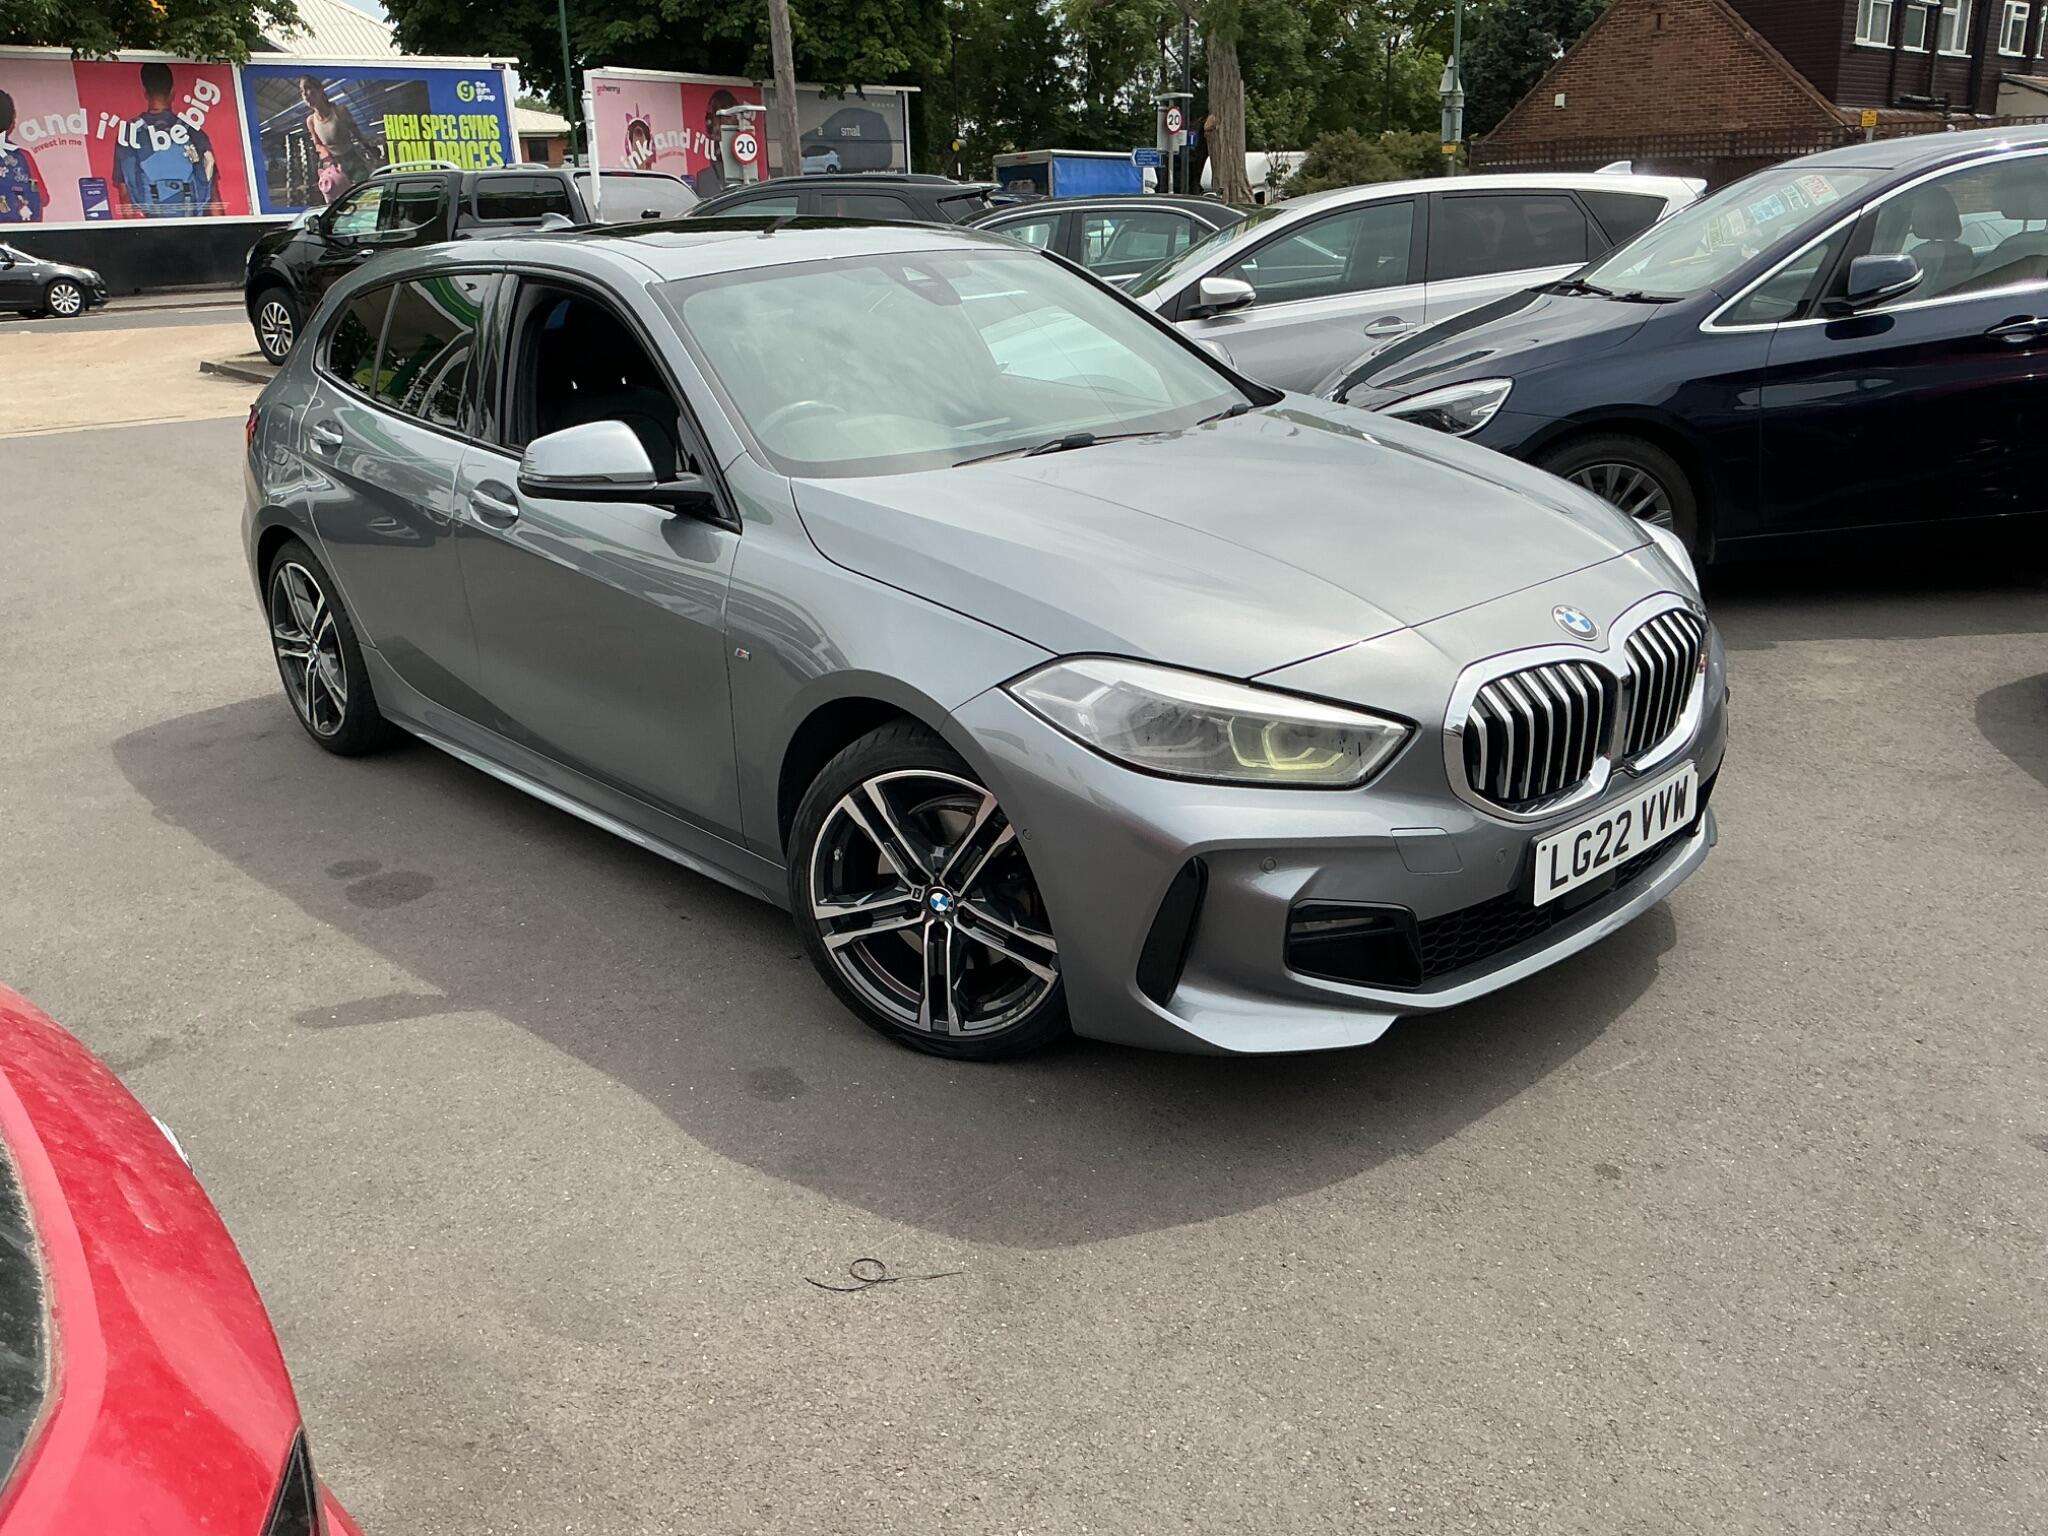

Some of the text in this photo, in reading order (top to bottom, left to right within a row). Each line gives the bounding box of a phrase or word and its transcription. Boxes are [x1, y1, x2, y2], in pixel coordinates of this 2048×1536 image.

[19, 108, 88, 141] and
[148, 124, 189, 151] be
[177, 78, 221, 131] big
[1168, 114, 1180, 126] 20
[383, 114, 500, 140] HIGH SPEC GYMS
[817, 125, 861, 136] a small
[31, 141, 58, 154] invest
[59, 137, 67, 146] in
[654, 128, 690, 150] and
[736, 140, 756, 154] 20
[387, 141, 504, 172] LOW PRICES
[1550, 775, 1688, 890] LG22 VVW
